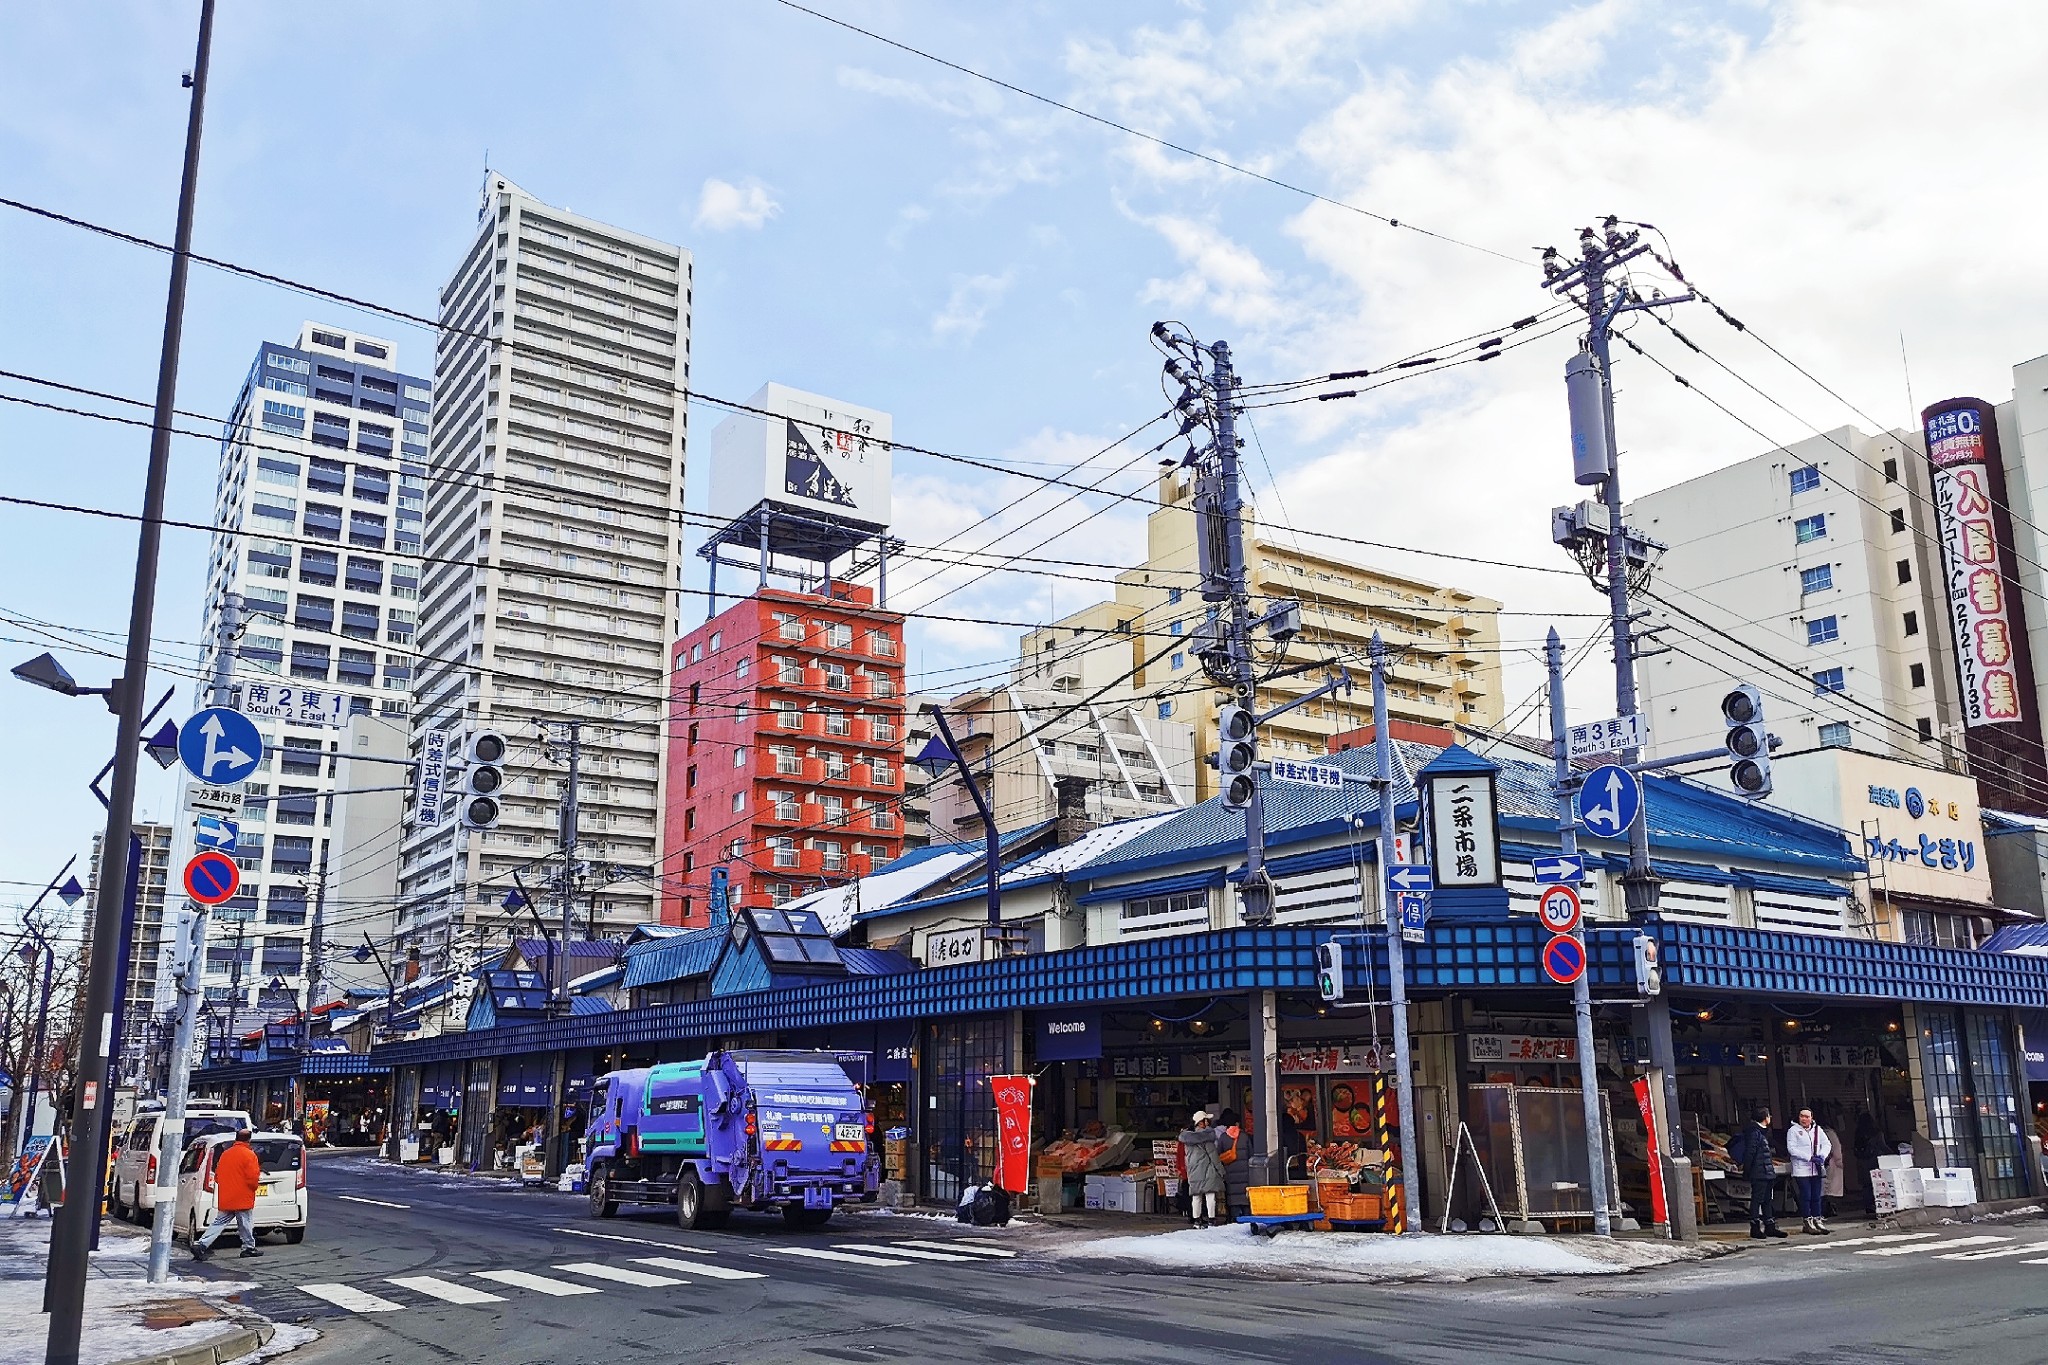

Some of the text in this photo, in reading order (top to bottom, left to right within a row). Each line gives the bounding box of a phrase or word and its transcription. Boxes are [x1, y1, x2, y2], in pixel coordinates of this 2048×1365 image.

[1936, 475, 1961, 572] アルファコート
[1956, 469, 2018, 719] 入居者募集
[1956, 603, 1981, 719] 272-7733
[247, 702, 337, 723] South 2 East 1
[1571, 733, 1638, 755] South 3 East 1
[418, 732, 443, 823] 時差式信号機
[1274, 761, 1340, 785] 時差式信号機
[189, 788, 242, 805] 一方通行路
[1928, 798, 1959, 821] 本店
[1450, 783, 1478, 878] 二条市場
[1406, 902, 1421, 923] 停
[1547, 898, 1571, 920] 50
[1048, 1021, 1086, 1035] Welcome
[1475, 1046, 1501, 1057] Tax-Free
[1508, 1037, 1575, 1060] 二条かに市場
